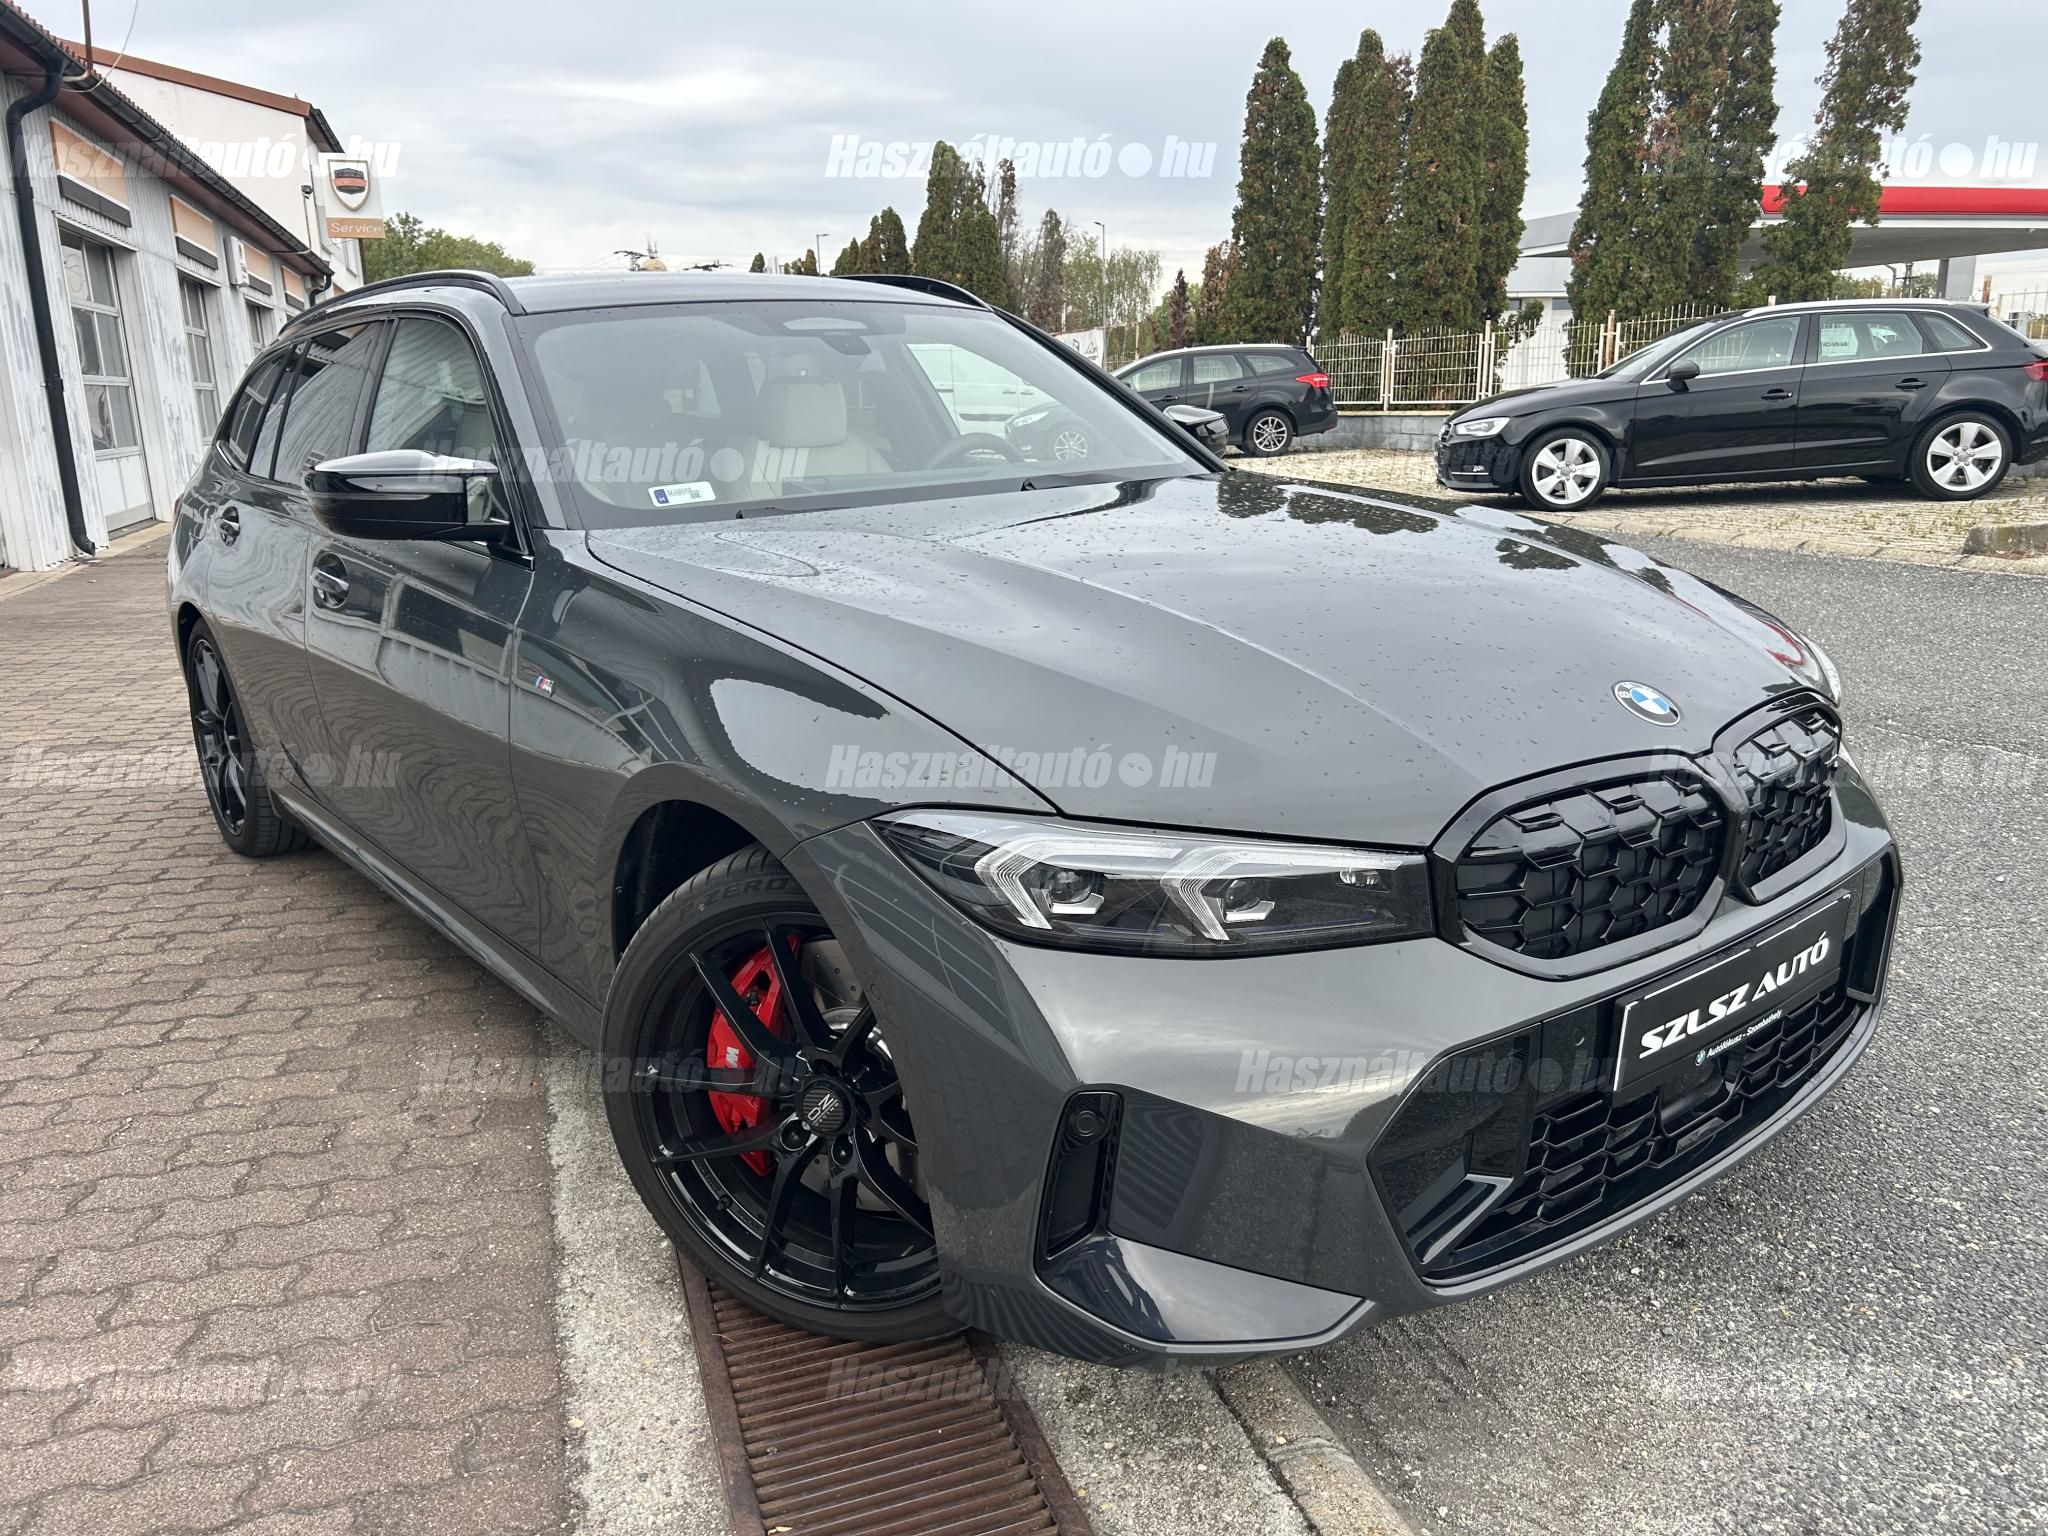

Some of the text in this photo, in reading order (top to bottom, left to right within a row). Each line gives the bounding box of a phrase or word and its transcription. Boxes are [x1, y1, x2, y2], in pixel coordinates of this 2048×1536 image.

[331, 222, 382, 233] Service
[703, 877, 790, 905] ZERO
[1639, 931, 1829, 1059] SZLSZ AUTÓ
